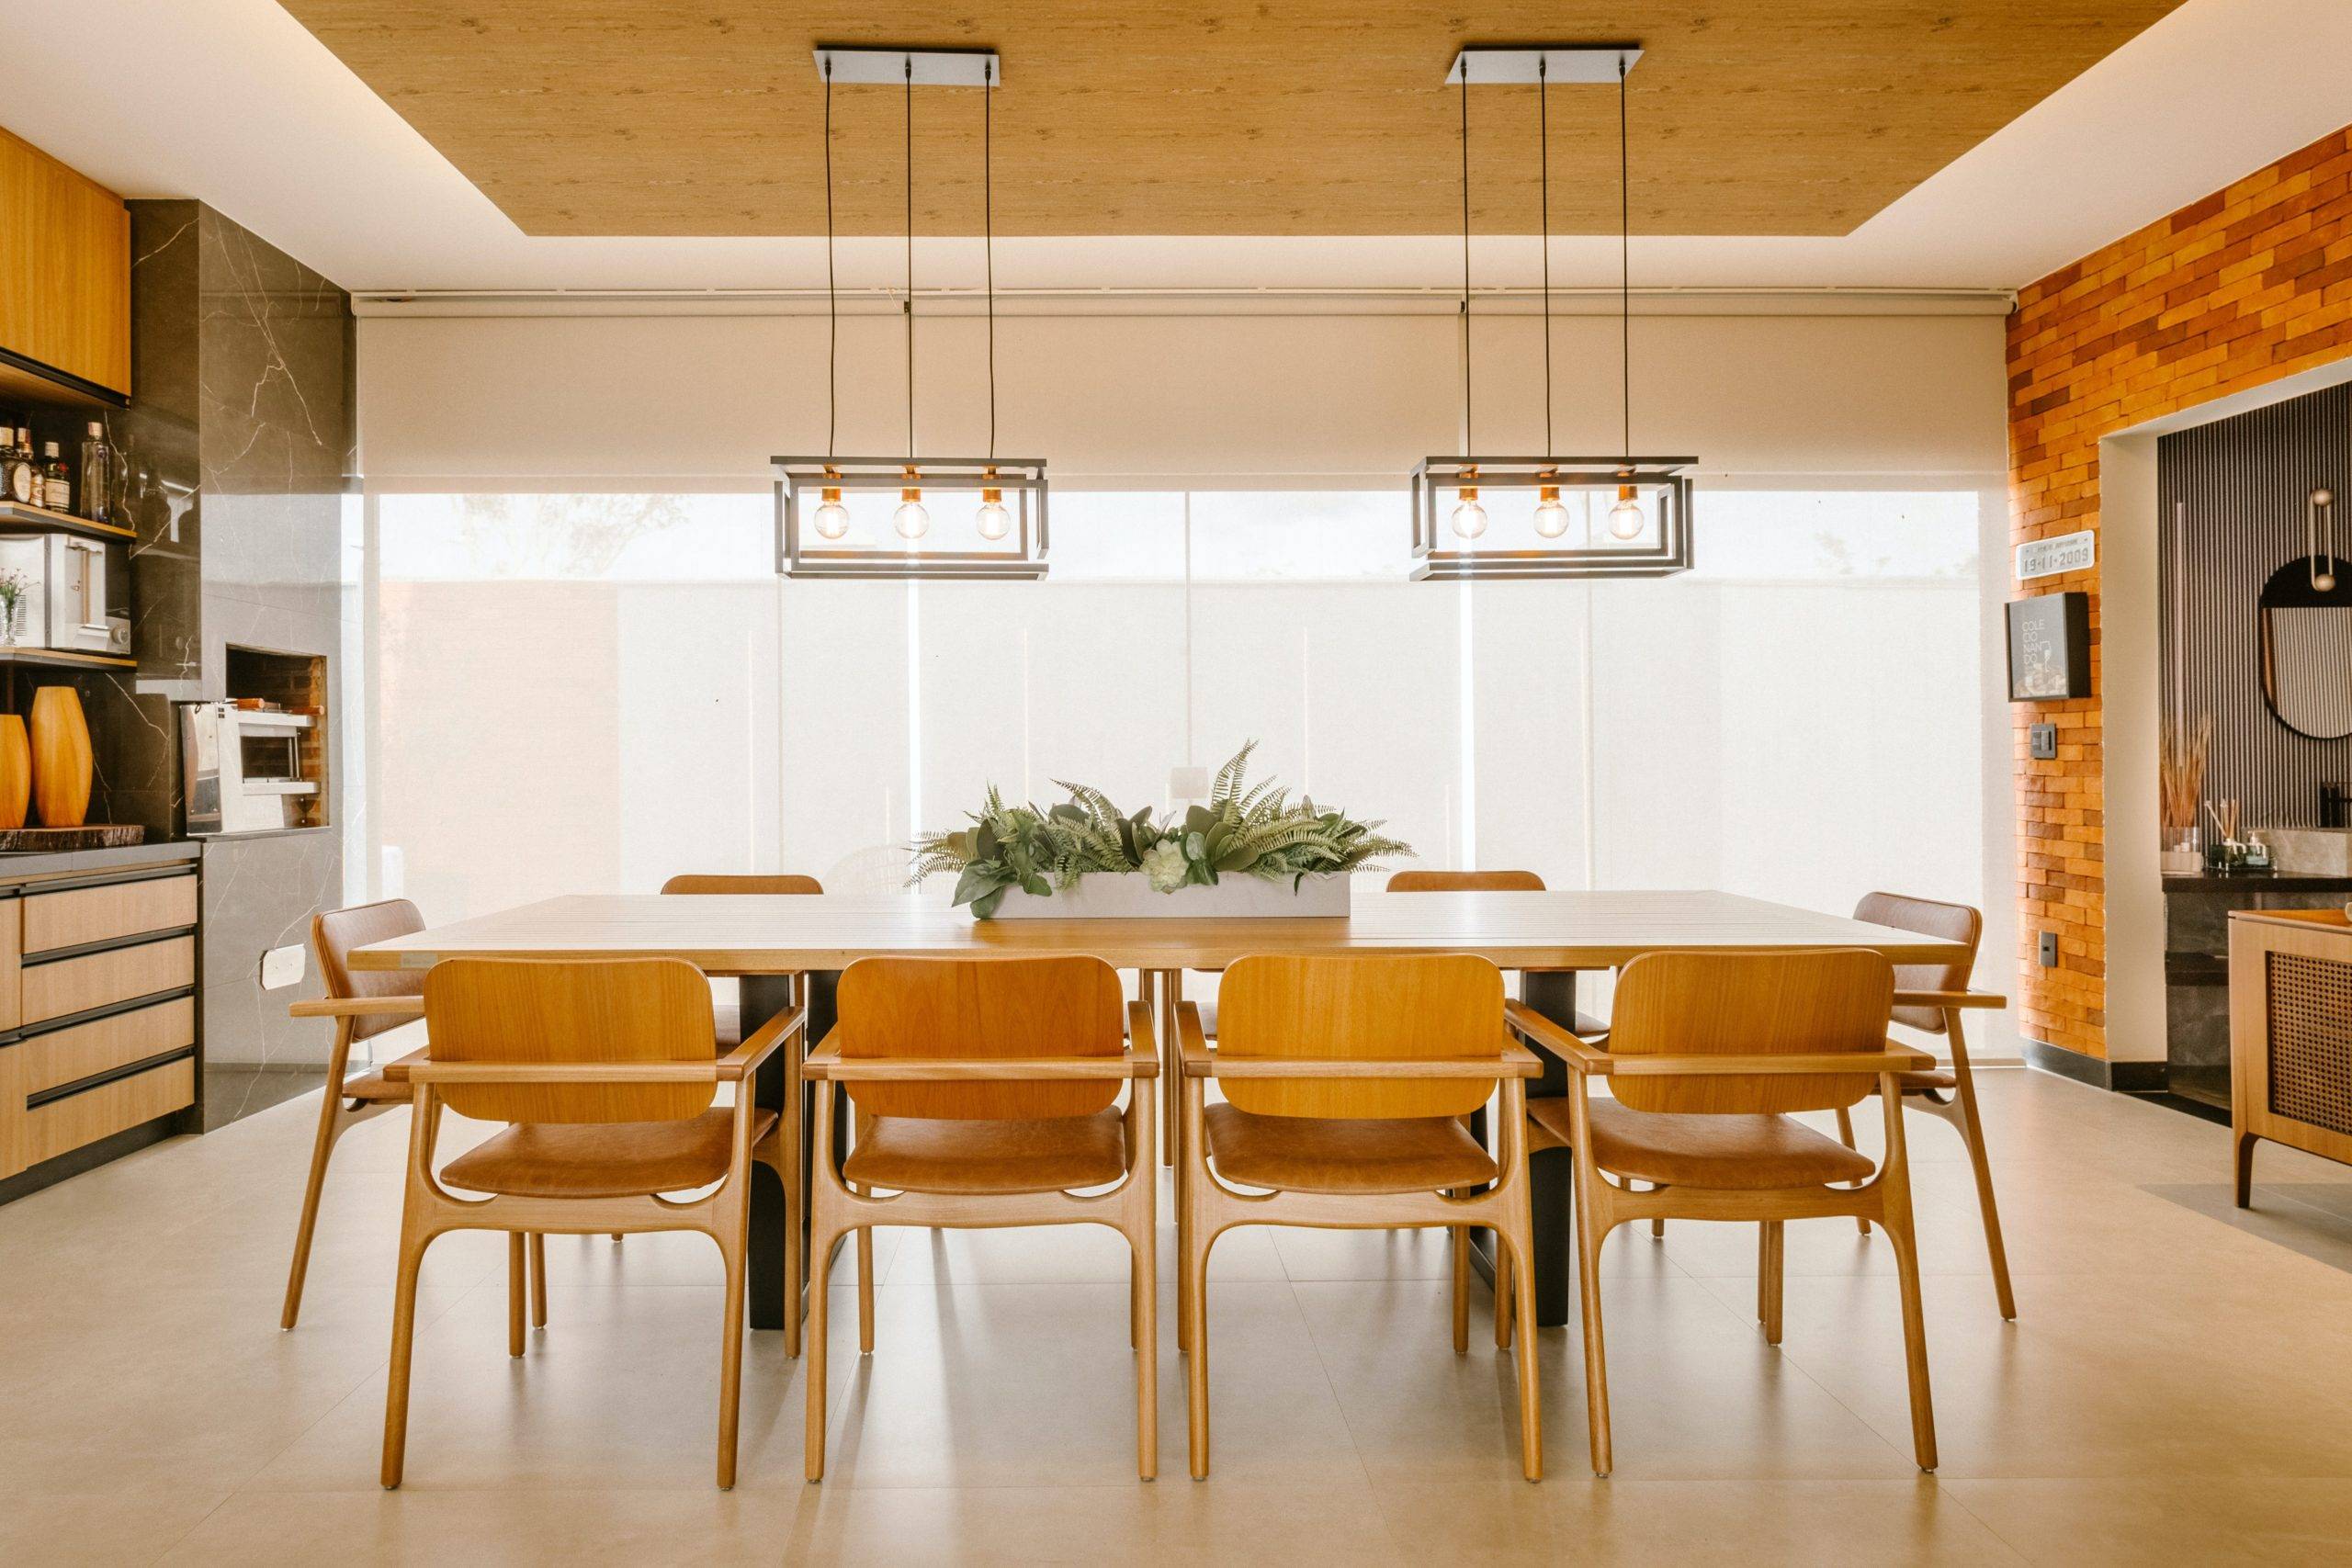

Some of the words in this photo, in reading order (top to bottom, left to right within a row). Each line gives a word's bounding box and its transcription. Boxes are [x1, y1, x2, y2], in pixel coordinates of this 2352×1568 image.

[2022, 618, 2045, 632] COLE
[2023, 642, 2042, 654] NAN
[2023, 653, 2038, 665] DO
